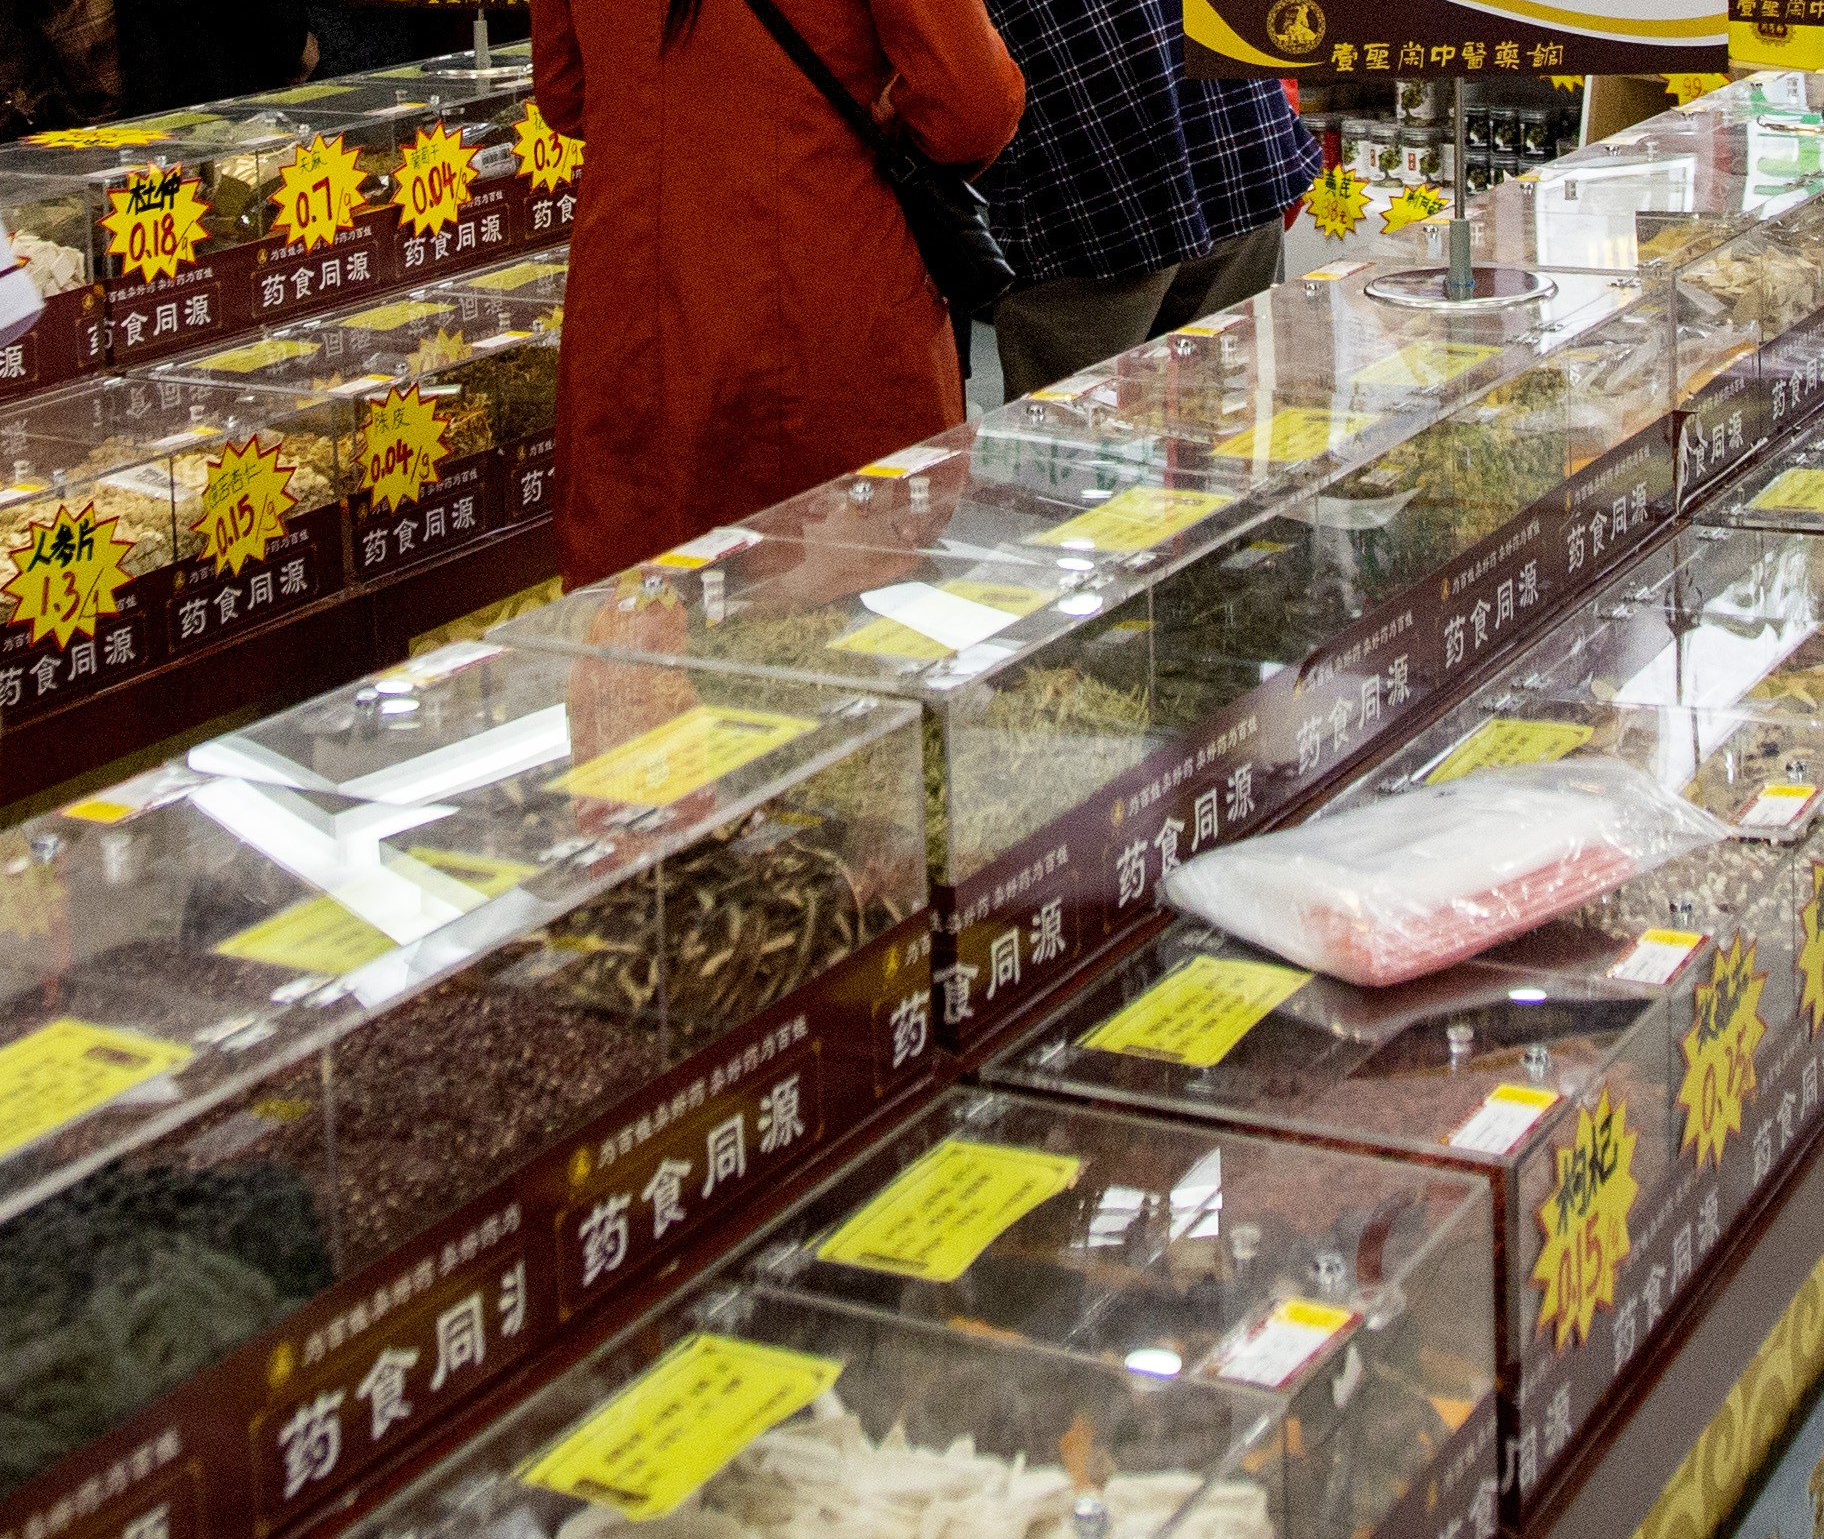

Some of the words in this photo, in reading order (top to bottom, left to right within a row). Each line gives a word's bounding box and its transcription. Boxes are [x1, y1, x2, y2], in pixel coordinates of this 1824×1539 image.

[262, 250, 372, 308] 药食同源
[403, 214, 503, 269] 药食同源
[87, 293, 212, 356] 药食同源
[521, 464, 556, 506] 药
[1567, 478, 1650, 574] 药食同源
[363, 495, 476, 567] 药食同源
[178, 557, 308, 640] 药食同源
[1443, 557, 1540, 670] 药食同源
[1295, 653, 1411, 777] 药食同源
[1116, 761, 1255, 909] 药食同源
[887, 897, 1067, 1068] 药食同源
[579, 1073, 808, 1289] 药食同源
